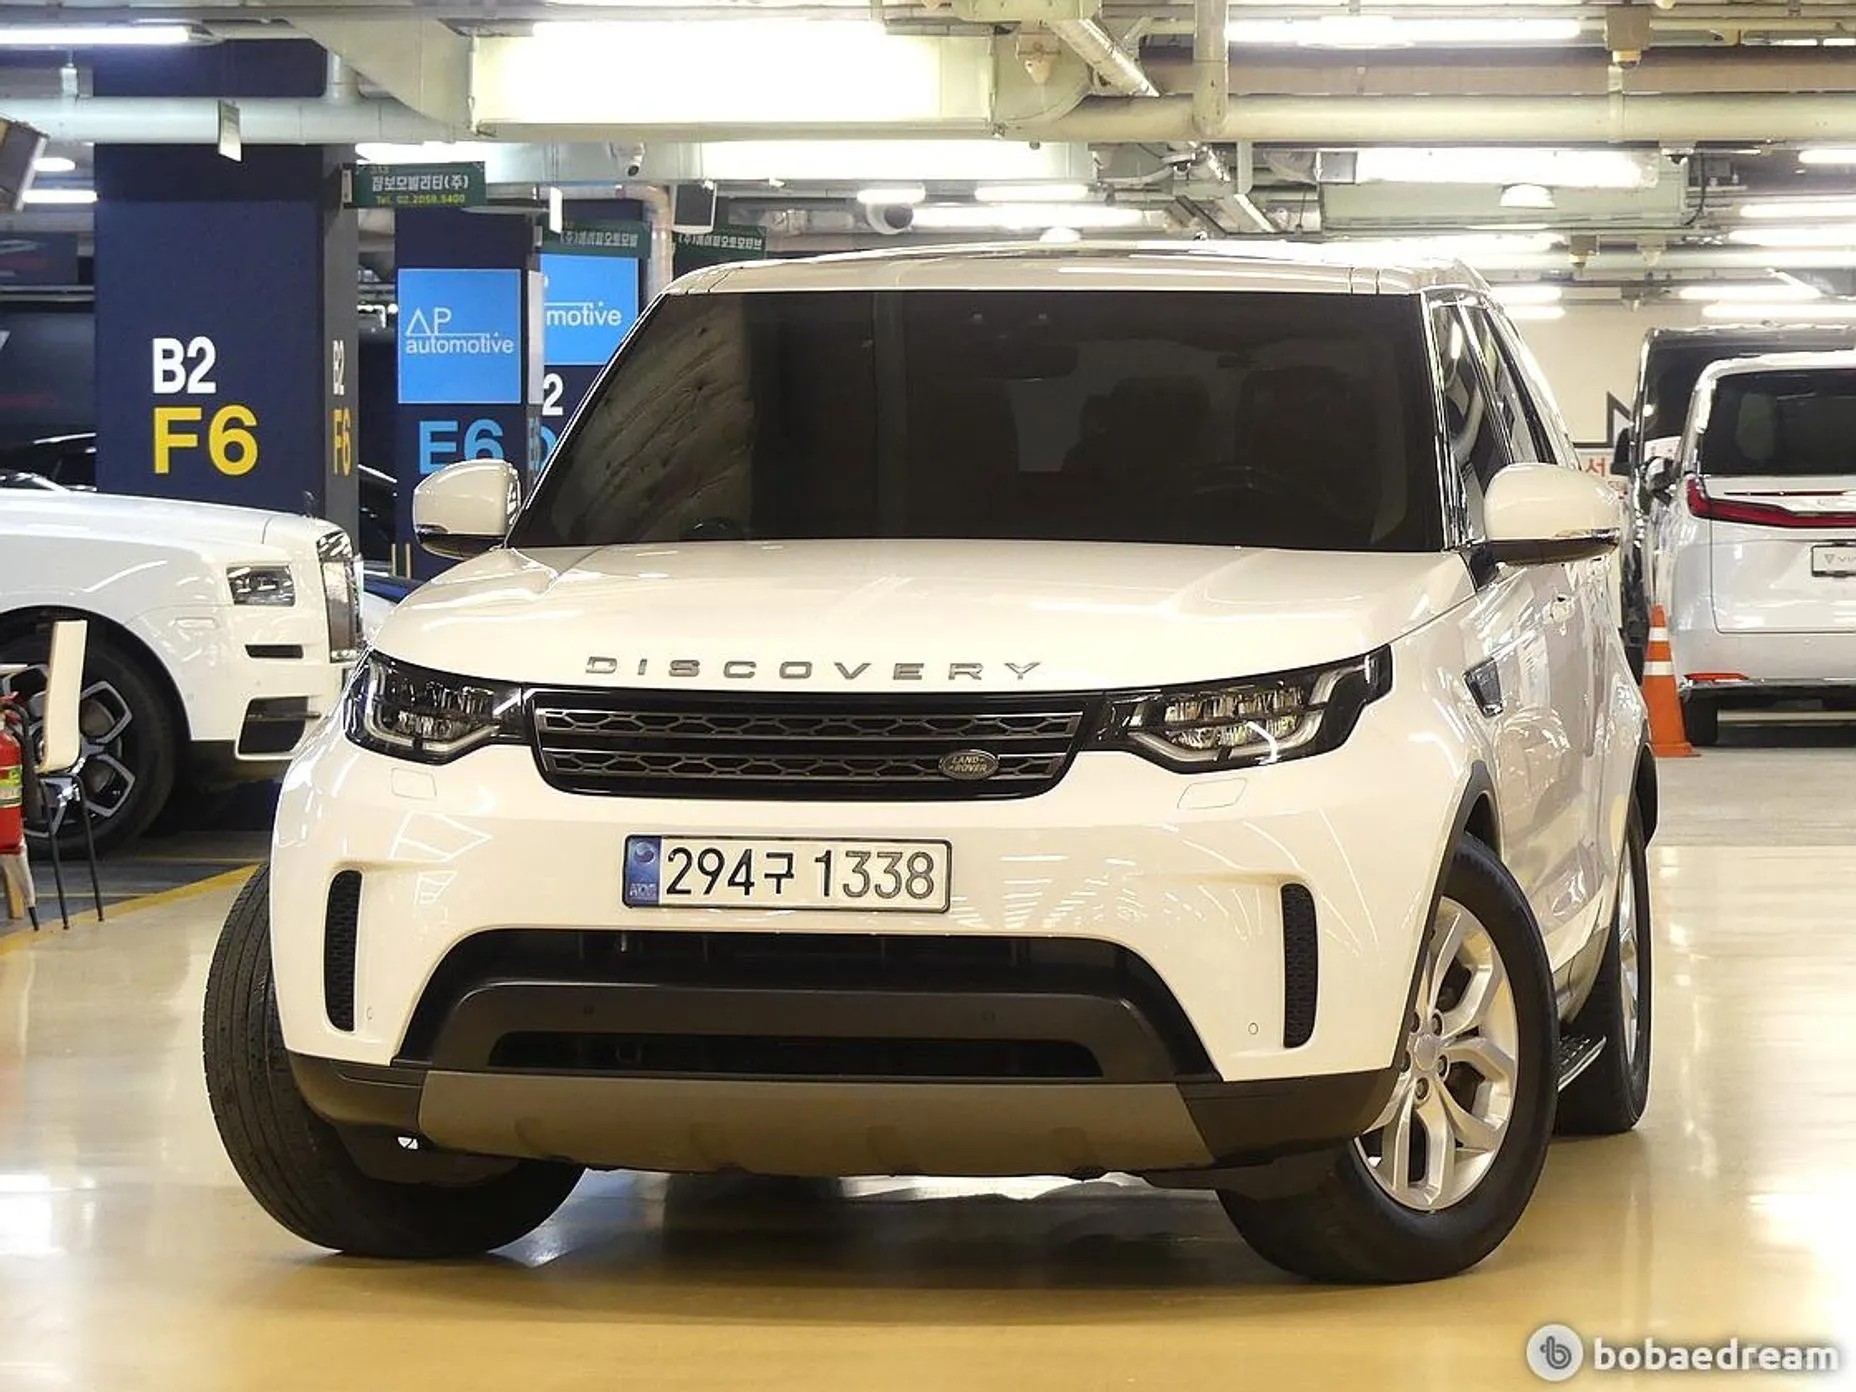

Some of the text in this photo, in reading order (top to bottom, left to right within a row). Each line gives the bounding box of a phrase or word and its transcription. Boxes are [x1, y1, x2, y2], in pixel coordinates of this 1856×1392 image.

[152, 335, 217, 395] B2
[332, 339, 345, 395] B2
[405, 337, 515, 354] automotive
[153, 404, 259, 476] F6
[332, 406, 351, 477] F6
[418, 419, 505, 475] E6
[584, 655, 1041, 682] DISCOVERY
[952, 756, 980, 764] LAND
[953, 763, 988, 772] ROVER
[665, 846, 935, 900] 294구 1338
